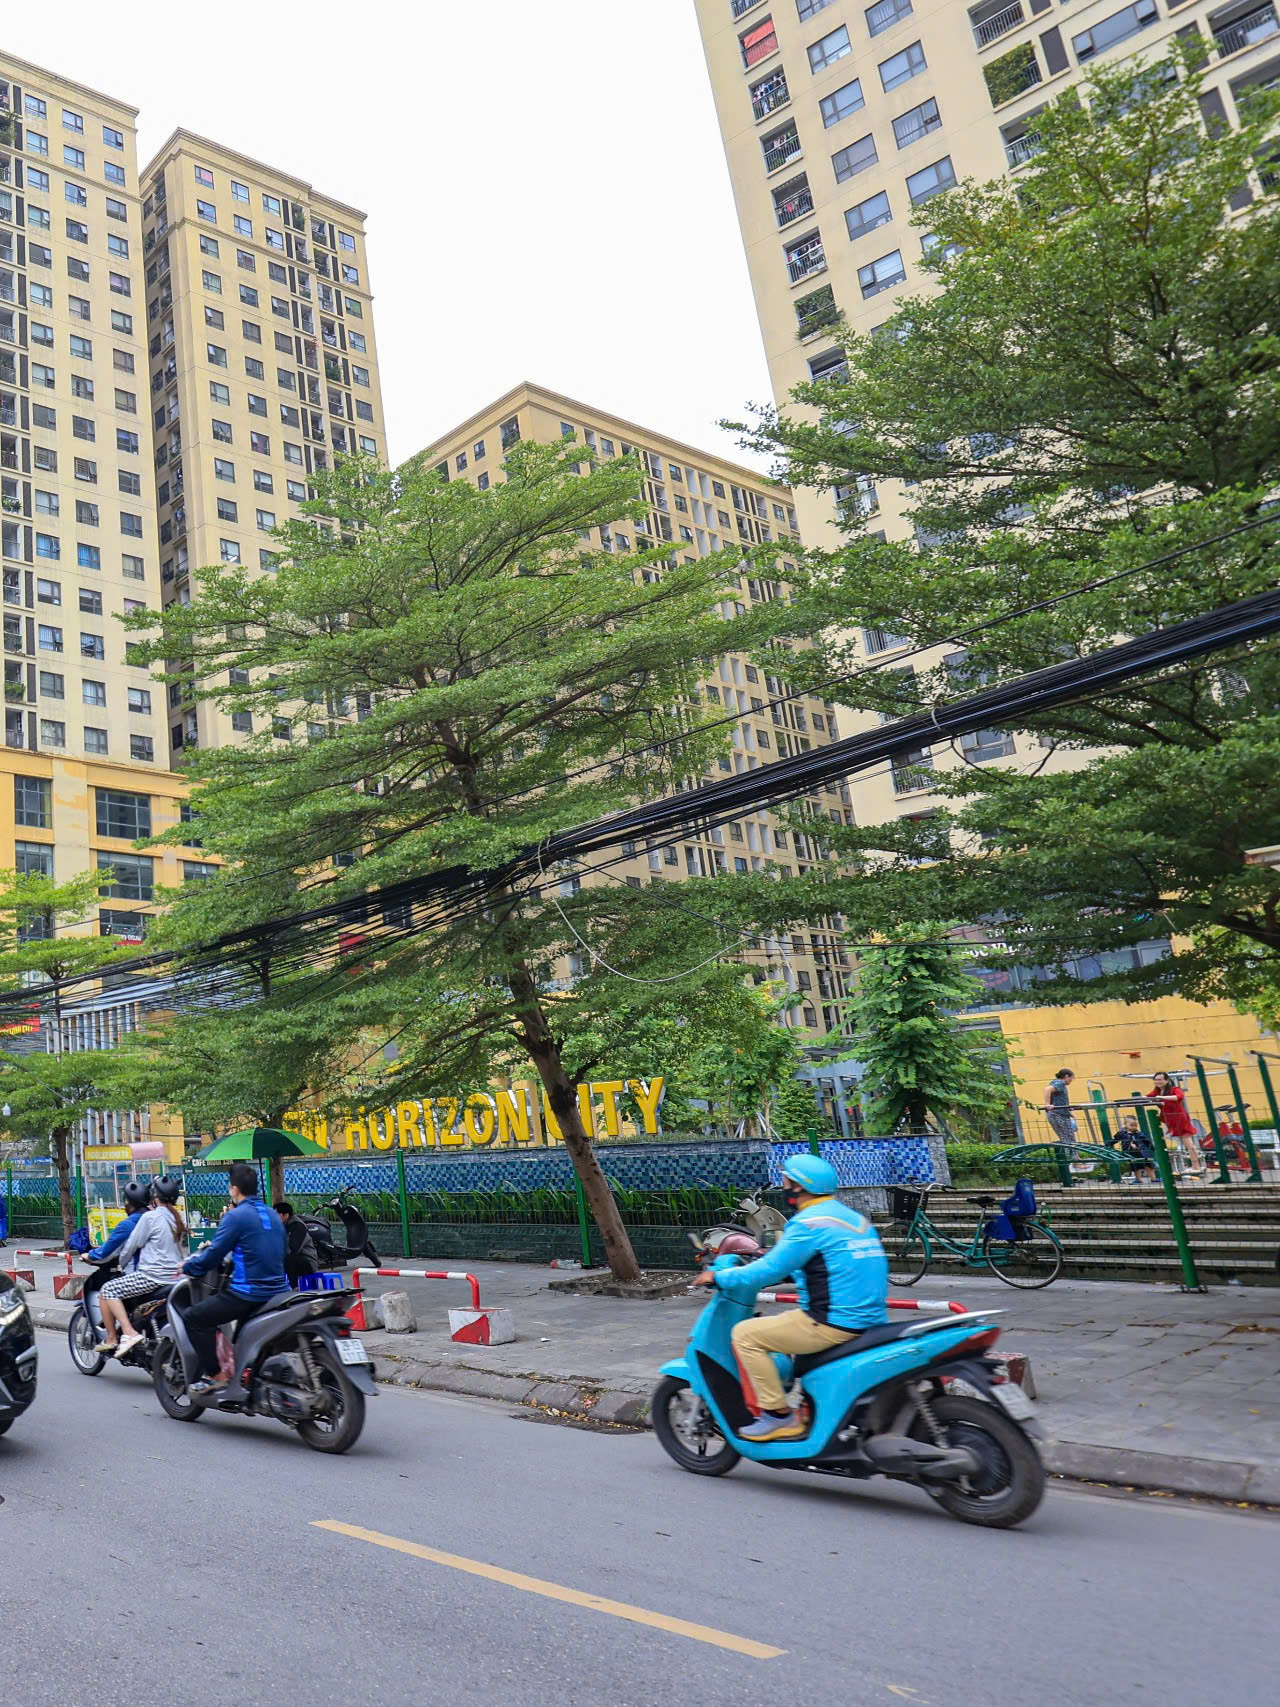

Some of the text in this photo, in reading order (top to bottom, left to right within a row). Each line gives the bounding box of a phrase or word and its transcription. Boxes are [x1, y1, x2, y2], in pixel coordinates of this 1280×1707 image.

[345, 1088, 532, 1151] HORIZON
[543, 1076, 664, 1140] CITY
[192, 1158, 206, 1167] CAFE
